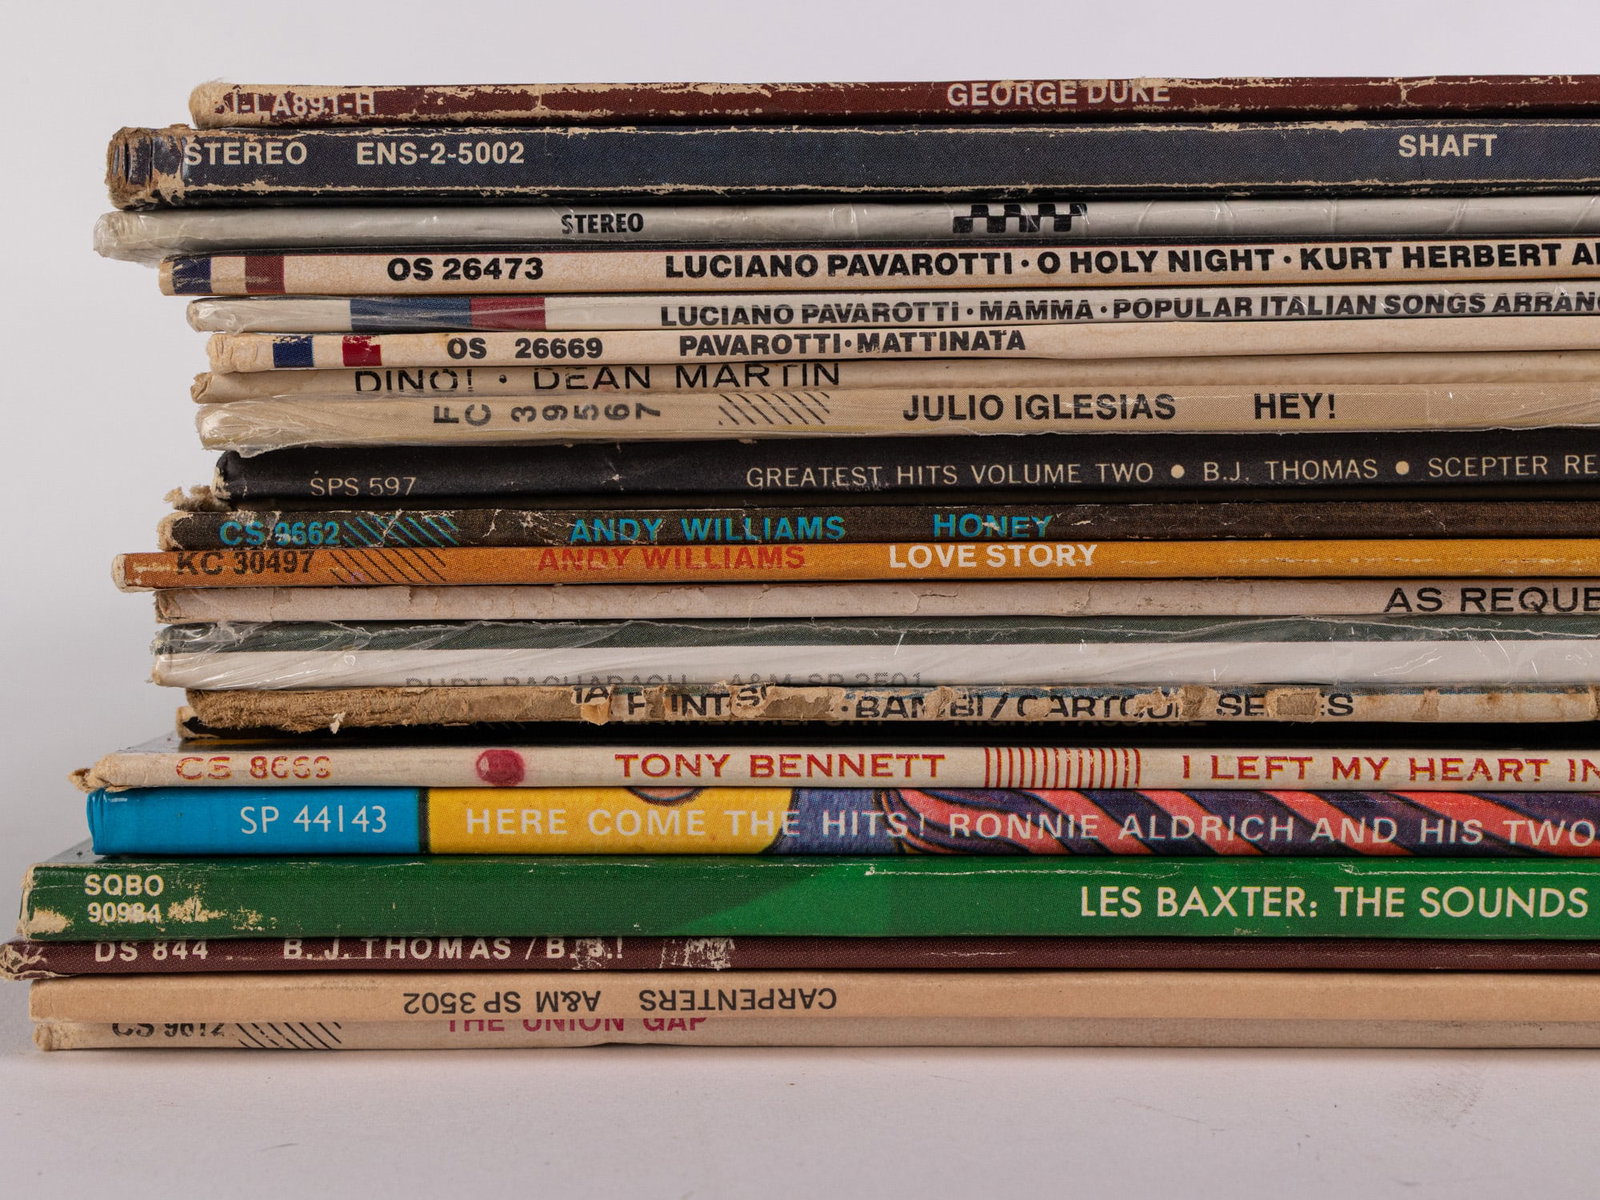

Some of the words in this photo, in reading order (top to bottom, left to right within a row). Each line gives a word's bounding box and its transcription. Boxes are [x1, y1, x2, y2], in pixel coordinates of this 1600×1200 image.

[947, 83, 1077, 107] GEORGE
[1088, 81, 1170, 105] DUKE
[183, 142, 307, 165] STEREO
[357, 142, 524, 165] ENS-2-5002
[1399, 134, 1497, 158] SHAFT
[561, 213, 644, 234] STEREO
[387, 258, 433, 281] OS
[443, 257, 543, 280] 26473
[666, 254, 818, 278] LUCIANO
[828, 252, 1012, 276] PAVAROTTI
[1038, 251, 1061, 274] O
[1071, 249, 1158, 273] HOLY
[1168, 248, 1274, 273] NIGHT
[1300, 246, 1393, 271] KURT
[1403, 243, 1562, 269] HERBERT
[1572, 242, 1600, 266] A
[661, 305, 794, 326] LUCIANO
[801, 302, 959, 323] PAVAROTTI
[980, 299, 1093, 321] MAMMA
[1113, 298, 1253, 319] POPULAR
[1260, 294, 1377, 317] ITALIAN
[1384, 292, 1486, 315] SONGS
[1492, 291, 1600, 313] ARRAN
[447, 337, 487, 359] OS
[515, 337, 604, 359] 26669
[680, 333, 840, 356] PAVAROTTI
[858, 330, 1026, 353] MATTINATA
[355, 368, 474, 392] DINO!
[533, 363, 651, 391] DEAN
[676, 362, 840, 388] MARTIN
[903, 394, 1002, 421] JULIO
[1015, 393, 1176, 420] IGLESIAS
[1254, 393, 1336, 419] HEY!
[310, 477, 360, 496] SPS
[368, 476, 418, 496] 597
[747, 466, 881, 488] GREATEST
[897, 464, 957, 486] HITS
[971, 463, 1082, 485] VOLUME
[1096, 463, 1153, 483] TWO
[1203, 461, 1249, 481] B.J.
[1265, 459, 1378, 480] THOMAS
[1428, 456, 1548, 477] SCEPTER
[219, 520, 265, 545] CS
[274, 520, 341, 546] 9662
[570, 518, 662, 543] ANDY
[681, 516, 845, 541] WILLIAMS
[934, 514, 1052, 538] HONEY
[177, 552, 223, 575] KC
[233, 551, 315, 574] 30497
[538, 548, 628, 572] ANDY
[642, 546, 806, 570] WILLIAMS
[889, 545, 977, 569] LOVE
[986, 544, 1098, 568] STORY
[1384, 587, 1442, 613] AS
[1459, 586, 1600, 613] REQUE
[176, 756, 232, 780] CS
[615, 754, 730, 778] TONY
[749, 754, 945, 778] BENNETT
[1182, 755, 1190, 779] I
[1210, 755, 1312, 779] LEFT
[1331, 756, 1389, 781] MY
[1408, 758, 1549, 782] HEART
[240, 806, 279, 834] SP
[293, 805, 387, 833] 44143
[466, 809, 567, 835] HERE
[588, 809, 705, 836] COME
[724, 810, 801, 837] THE
[822, 812, 925, 838] HITS!
[950, 813, 1100, 840] RONNIE
[1118, 815, 1294, 842] ALDRICH
[1310, 817, 1397, 844] AND
[1420, 818, 1484, 845] HIS
[1502, 819, 1595, 846] TWO
[84, 874, 164, 897] SQBO
[87, 902, 162, 923] 90984
[1081, 886, 1142, 918] LES
[1157, 886, 1318, 918] BAXTER:
[1334, 886, 1405, 918] THE
[1419, 886, 1589, 919] SOUNDS
[94, 941, 137, 962] DS
[152, 939, 209, 961] 844
[361, 939, 511, 960] THOMAS
[403, 991, 477, 1014] 3502
[483, 991, 521, 1012] SP
[536, 990, 601, 1012] A&M
[640, 987, 837, 1011] CARPENTERS
